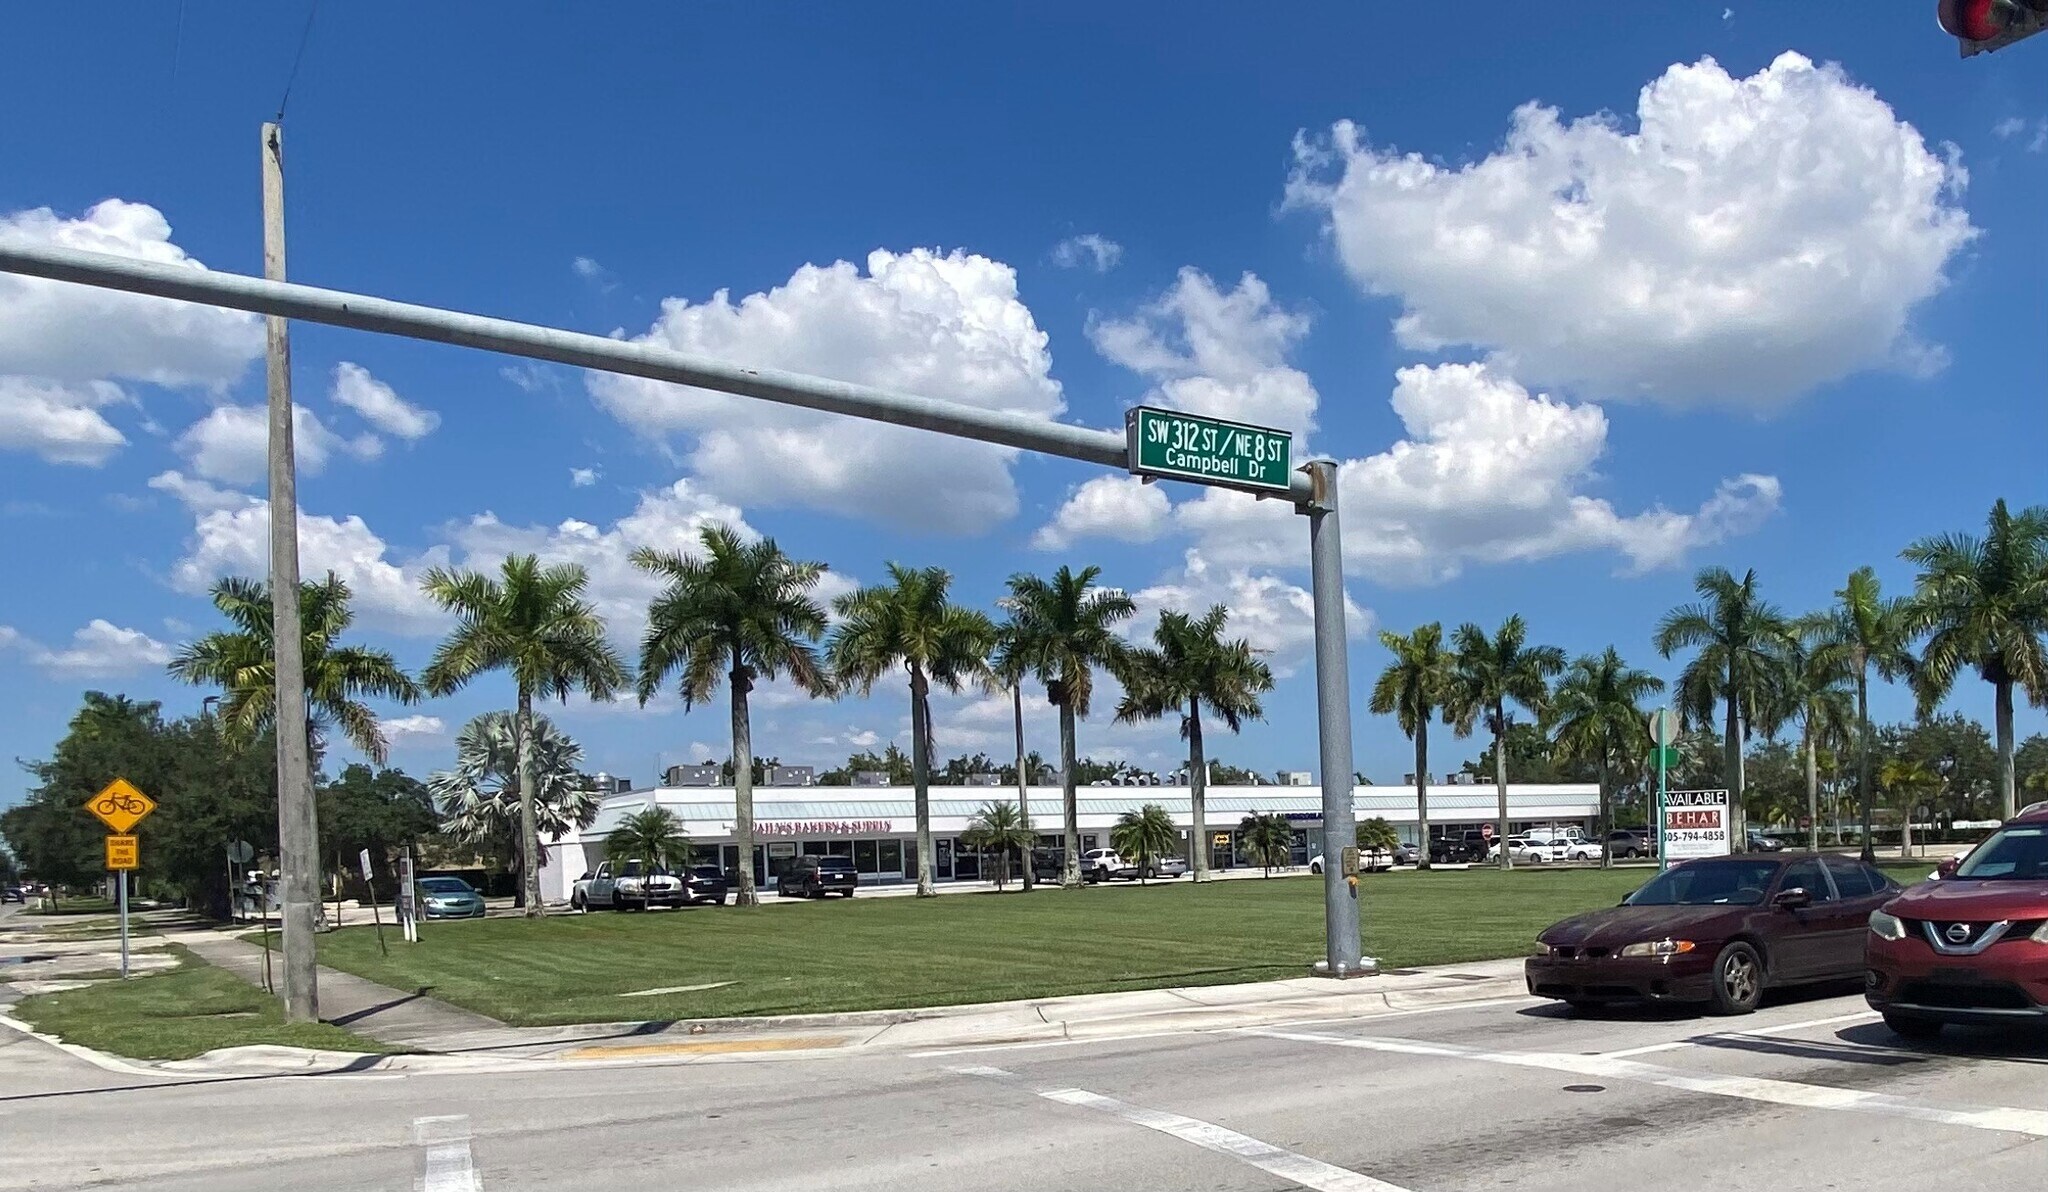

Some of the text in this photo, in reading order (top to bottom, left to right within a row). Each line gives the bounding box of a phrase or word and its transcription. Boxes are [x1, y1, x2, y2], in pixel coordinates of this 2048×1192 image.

[1148, 418, 1169, 444] SW
[1172, 420, 1200, 452] 312
[1202, 429, 1218, 452] ST
[1235, 433, 1252, 458] NE
[1254, 434, 1264, 462] 8
[1267, 438, 1283, 462] ST
[1166, 447, 1266, 479] Campbell Dr
[1666, 811, 1719, 825] BEHAR
